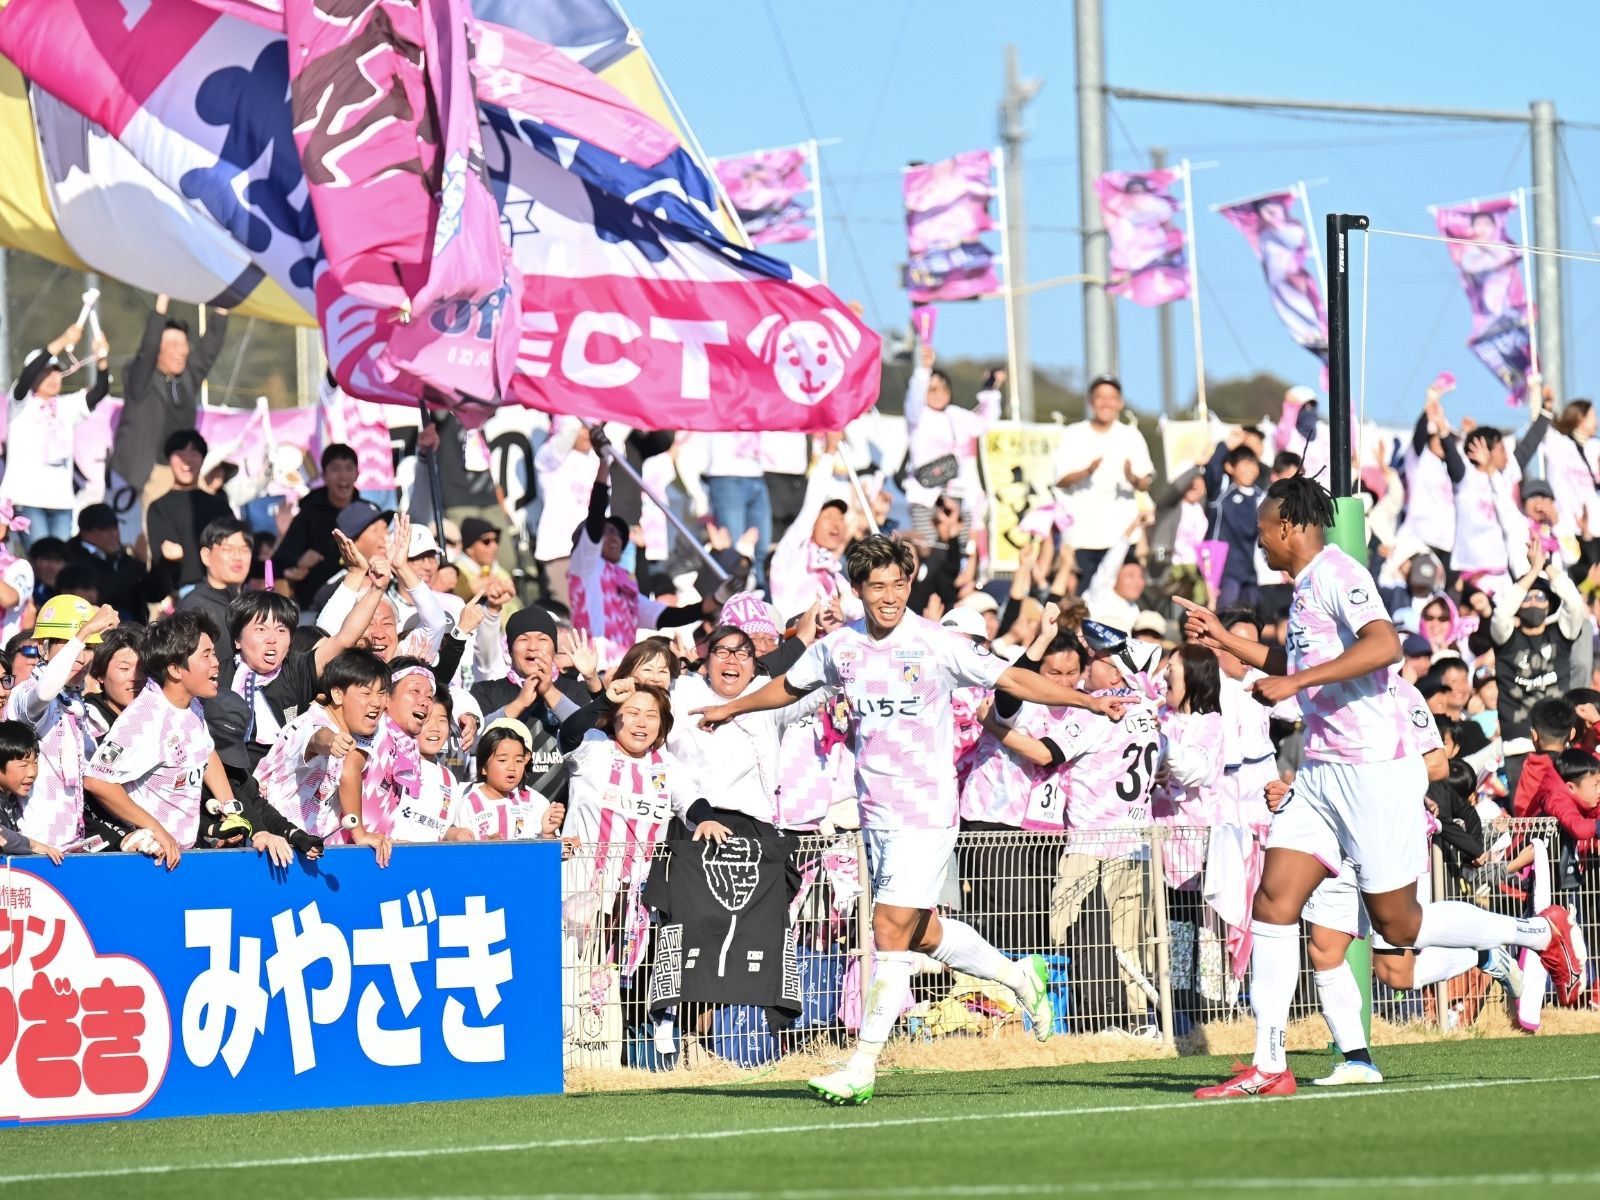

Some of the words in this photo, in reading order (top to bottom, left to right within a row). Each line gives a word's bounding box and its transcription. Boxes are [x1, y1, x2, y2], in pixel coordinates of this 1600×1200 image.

[857, 696, 921, 717] いちご
[189, 763, 208, 786] い
[620, 795, 668, 820] いちご
[0, 884, 32, 910] 情報
[181, 888, 513, 1078] みやざき
